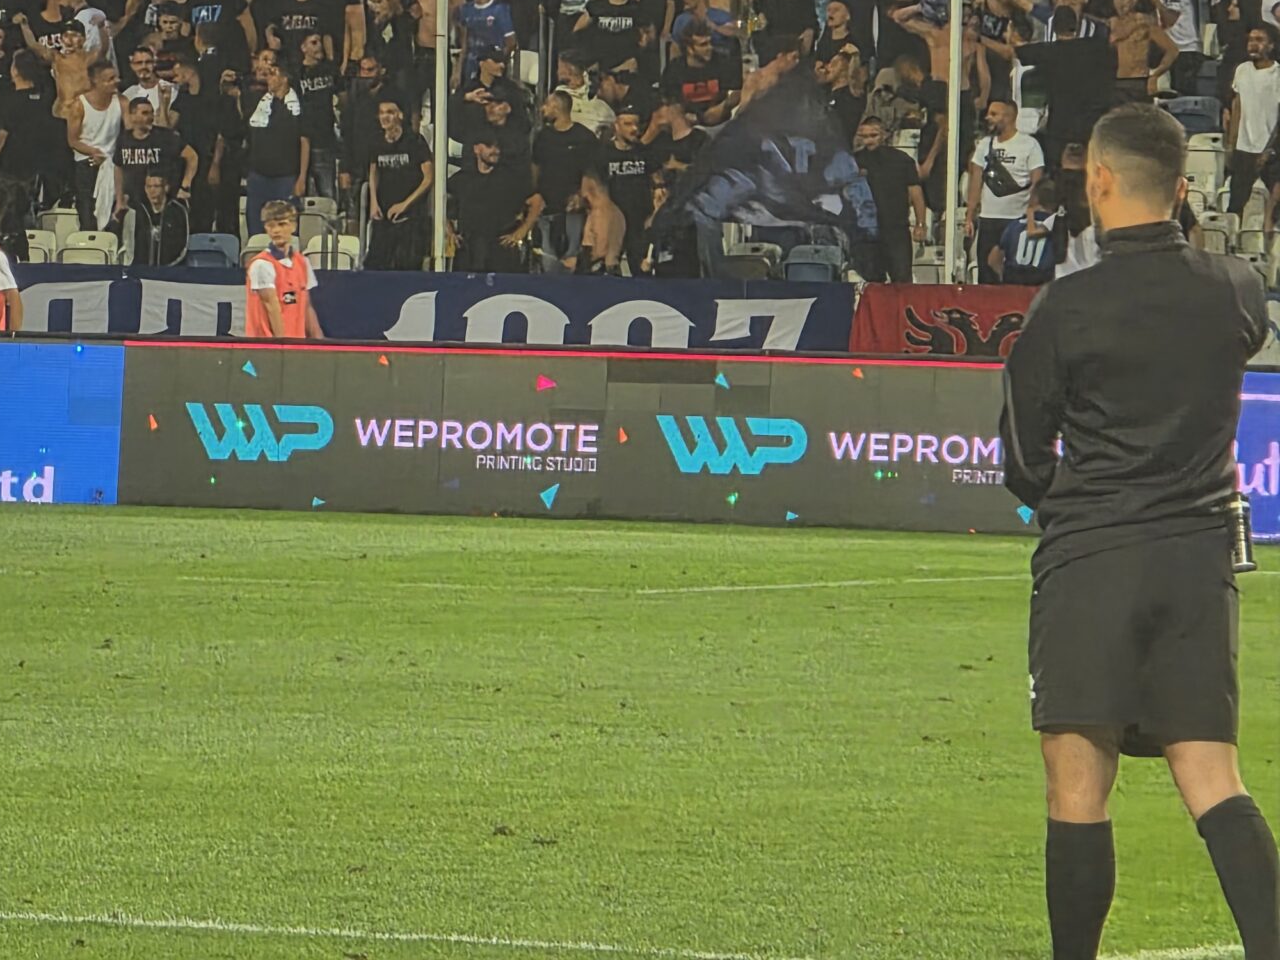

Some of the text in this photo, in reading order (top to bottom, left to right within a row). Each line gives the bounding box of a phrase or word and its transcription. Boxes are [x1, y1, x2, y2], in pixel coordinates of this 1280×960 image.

[354, 418, 598, 452] WEPROMOTE
[829, 432, 1003, 465] WEPROM
[476, 455, 597, 472] PRINTING STUDIO
